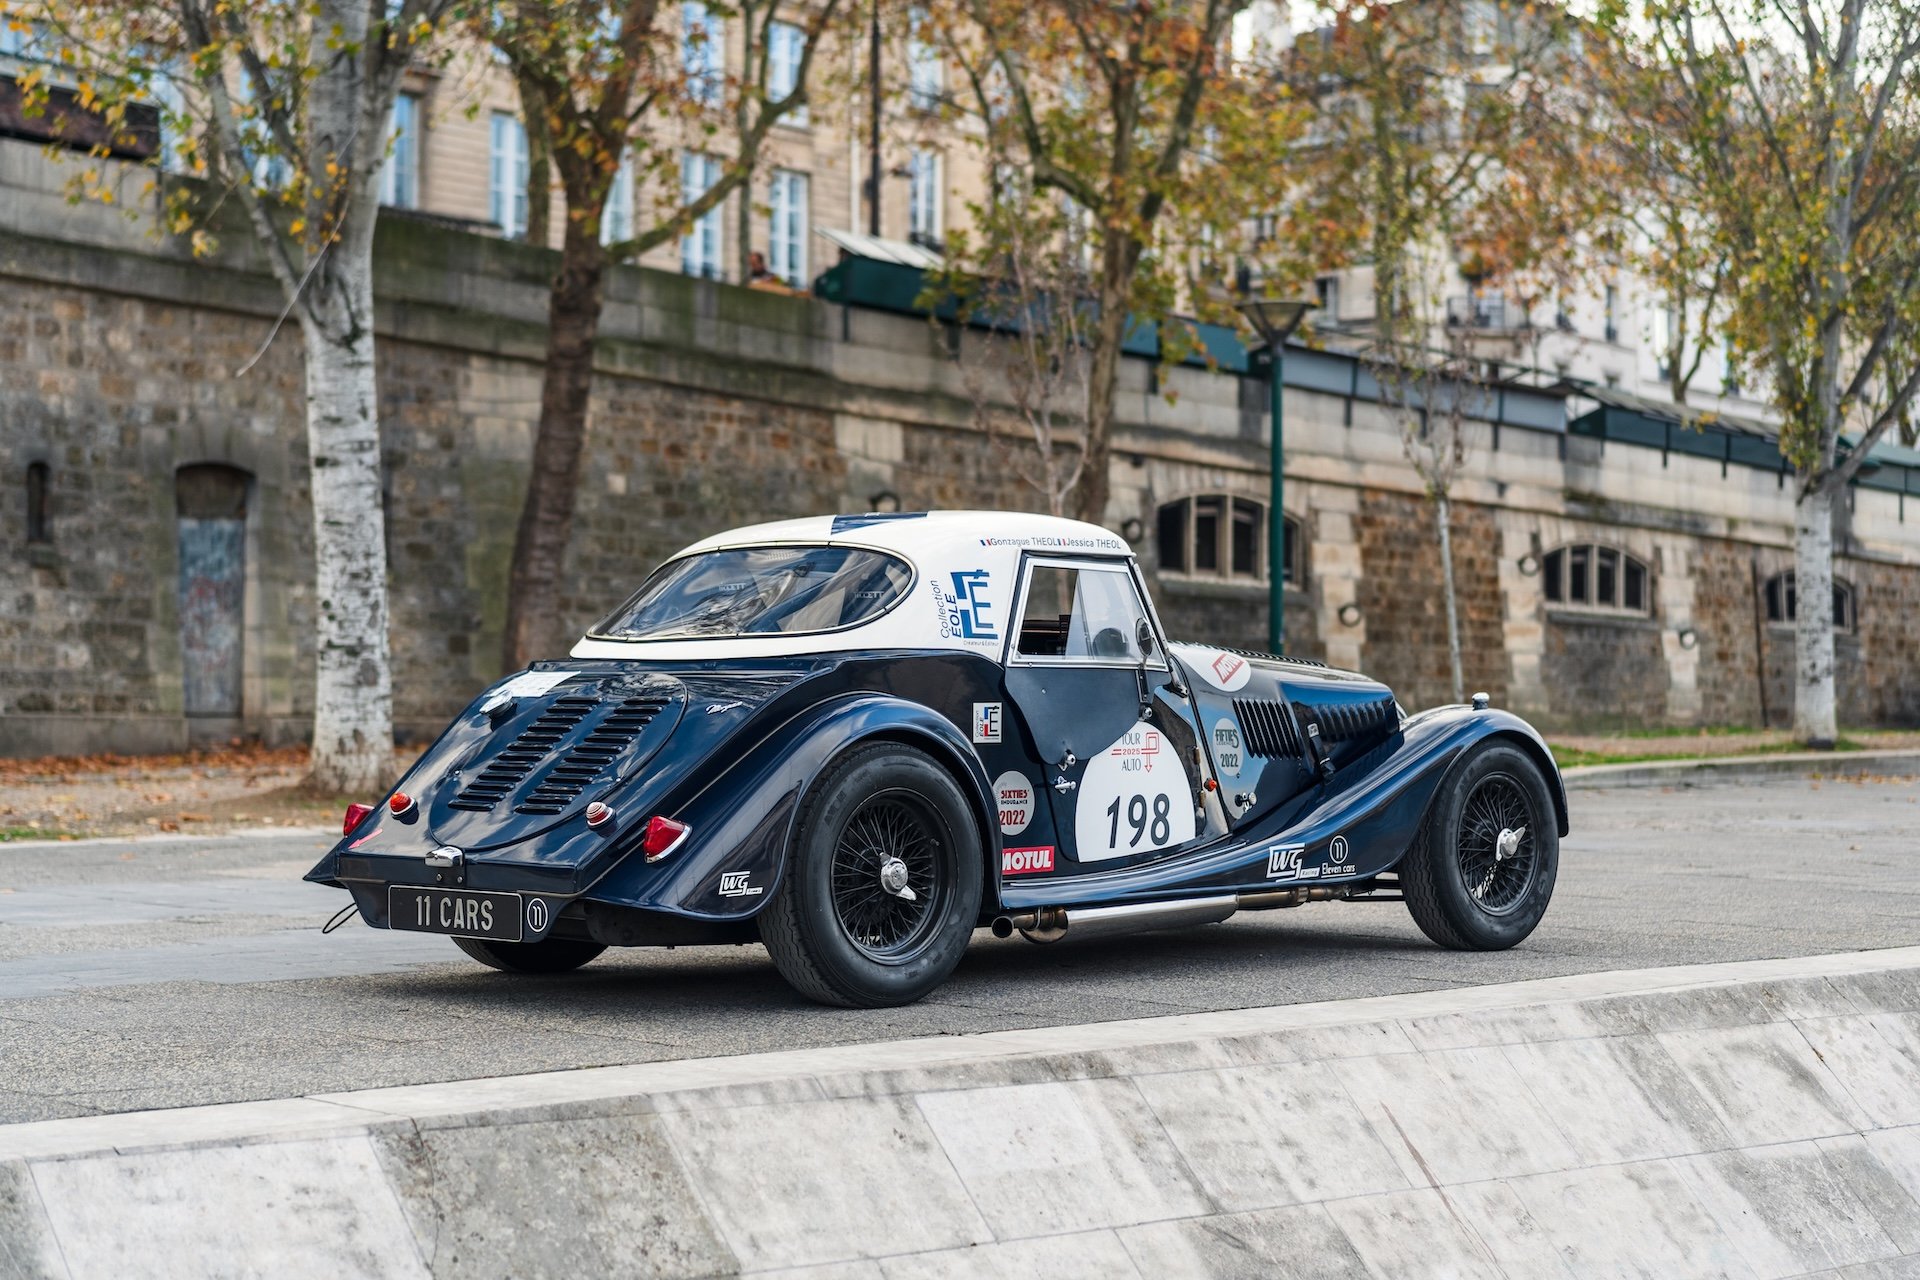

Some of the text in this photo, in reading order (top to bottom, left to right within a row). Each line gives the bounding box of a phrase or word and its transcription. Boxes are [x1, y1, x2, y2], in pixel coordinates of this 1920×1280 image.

[1031, 537, 1058, 546] THEOL
[1066, 538, 1121, 549] Jessica THEOL
[930, 580, 949, 638] Collection
[1121, 732, 1141, 745] TOUR
[1121, 758, 1142, 771] AUTO
[1220, 753, 1239, 767] 2022
[1000, 810, 1025, 825] 2022
[1106, 793, 1170, 849] 198
[1002, 850, 1052, 871] MOTUL
[1322, 862, 1355, 874] Eleven cars
[415, 895, 494, 931] 11 CARS
